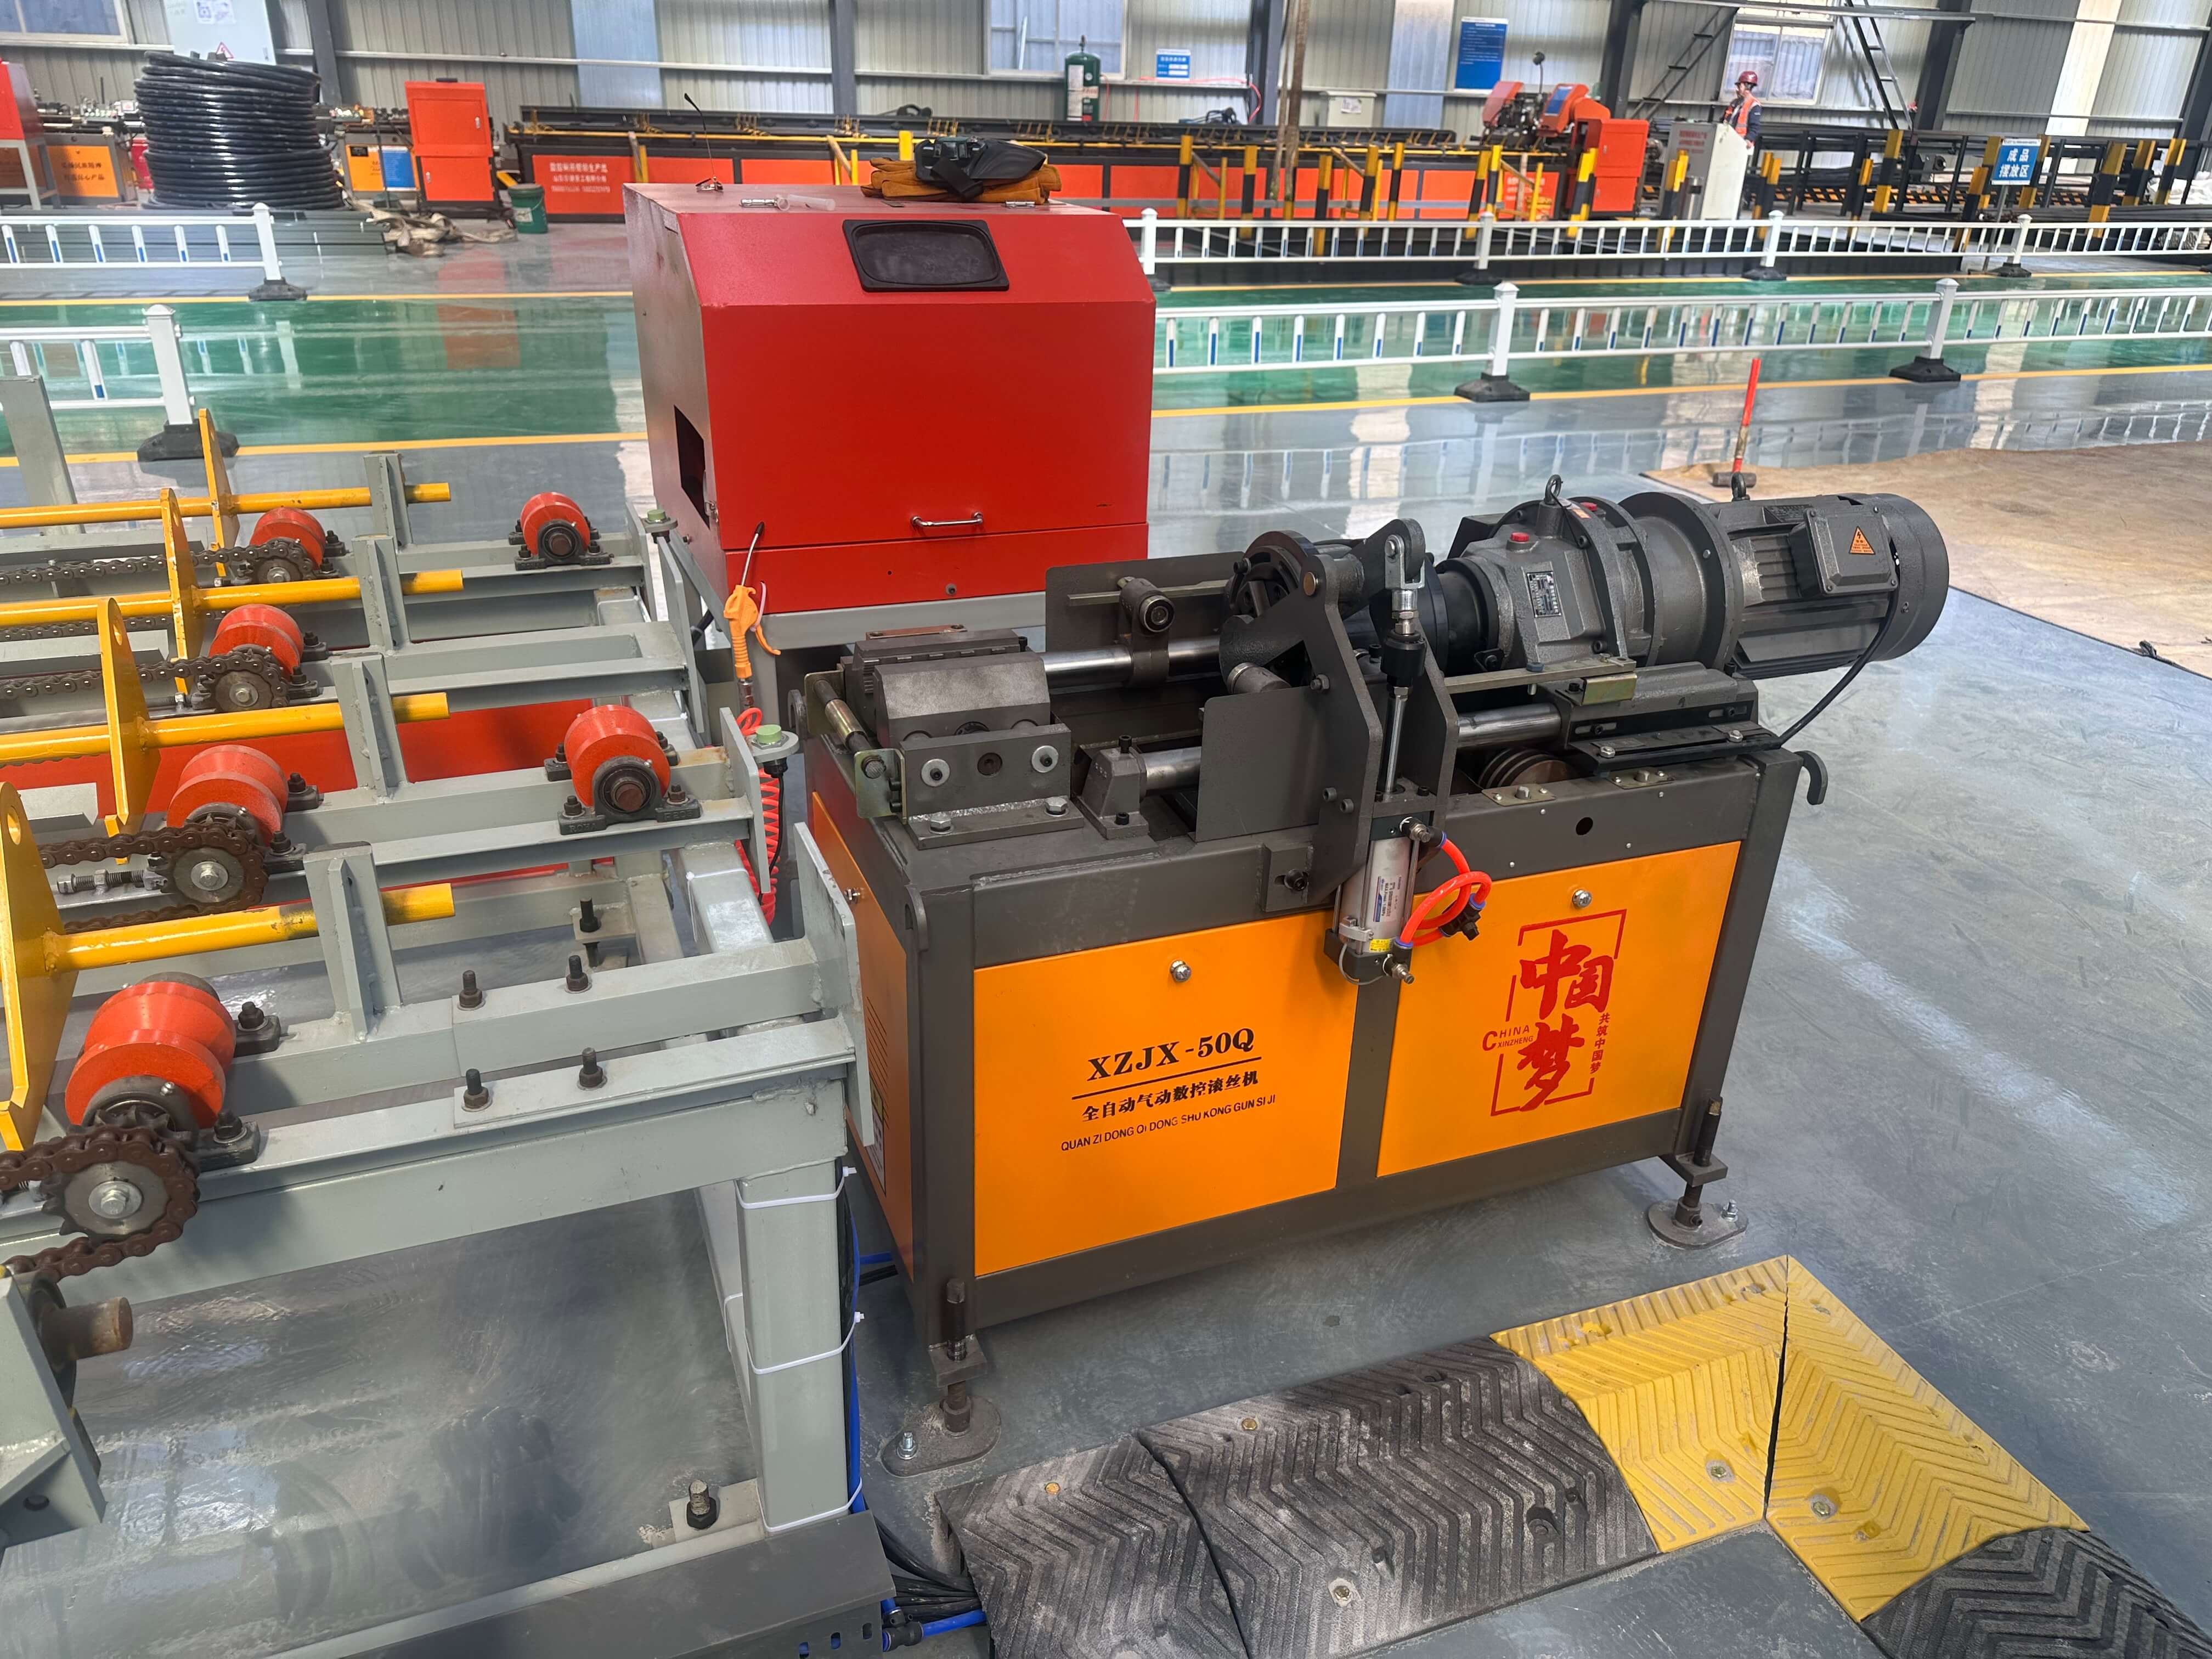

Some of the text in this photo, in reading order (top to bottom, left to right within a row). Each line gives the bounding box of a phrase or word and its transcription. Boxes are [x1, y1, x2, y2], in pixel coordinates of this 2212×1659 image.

[1482, 1025, 1530, 1051] CHINA
[1497, 1035, 1534, 1048] XINZHENG
[1589, 1012, 1611, 1075] 共筑中国梦
[1082, 1070, 1259, 1122] 全自动气动数控滚丝机
[1061, 1137, 1090, 1151] QUAN
[1093, 1134, 1102, 1144] ZI
[1104, 1127, 1135, 1142] DONG
[1149, 1117, 1178, 1131] DONG
[1181, 1113, 1201, 1124] SHU
[1203, 1105, 1232, 1119] KONG
[1233, 1100, 1255, 1111] GUN
[1256, 1097, 1266, 1107] SI
[1267, 1094, 1276, 1105] JI
